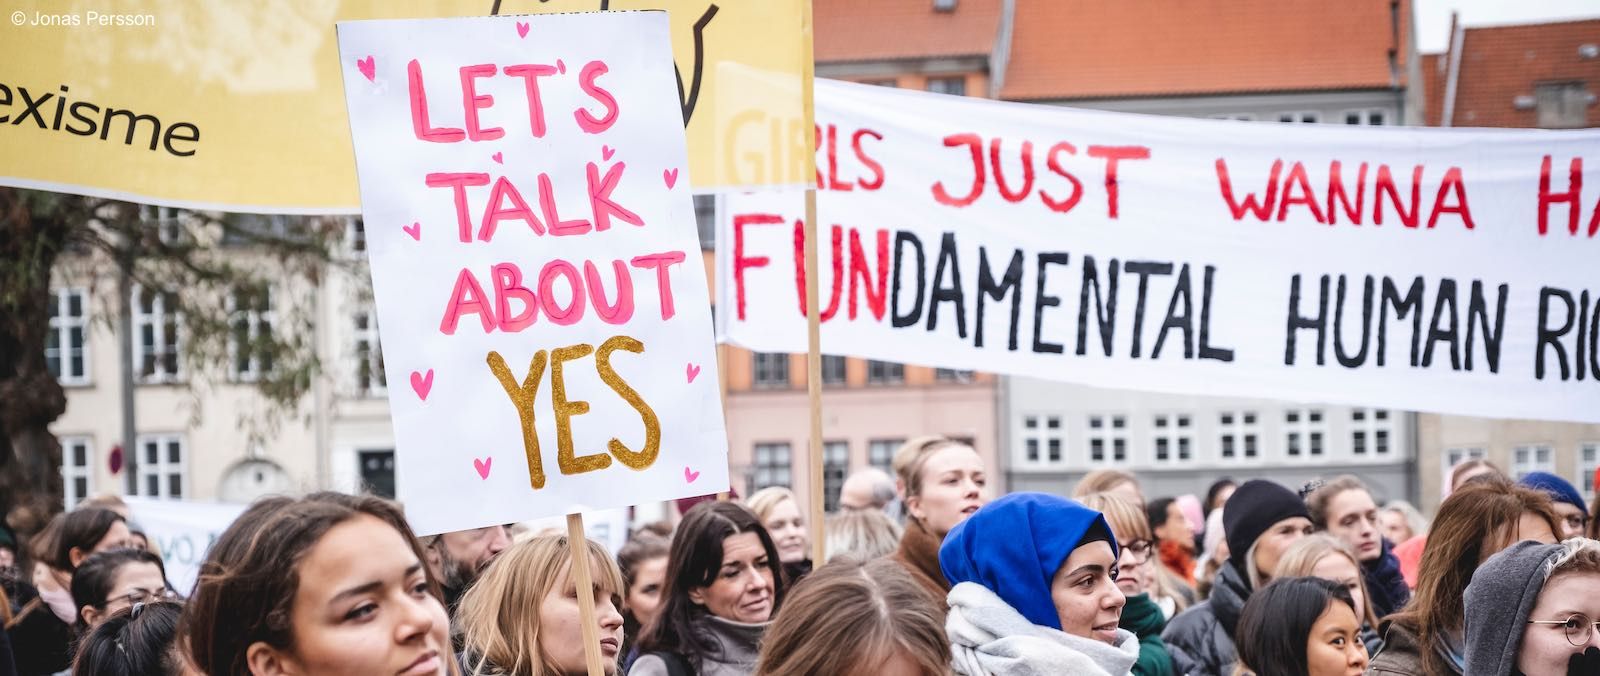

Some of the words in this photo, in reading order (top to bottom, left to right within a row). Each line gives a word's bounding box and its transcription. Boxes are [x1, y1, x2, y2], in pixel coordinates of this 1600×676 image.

[408, 60, 620, 142] LET'S
[425, 161, 645, 243] TALK
[932, 133, 1151, 219] JUST
[1215, 158, 1475, 230] WANNA
[1537, 155, 1600, 238] H
[440, 251, 686, 335] ABOUT
[732, 213, 1235, 362] FUNDAMENTAL
[1285, 274, 1509, 373] HUMAN
[1535, 286, 1600, 381] RI
[486, 335, 661, 490] YES
